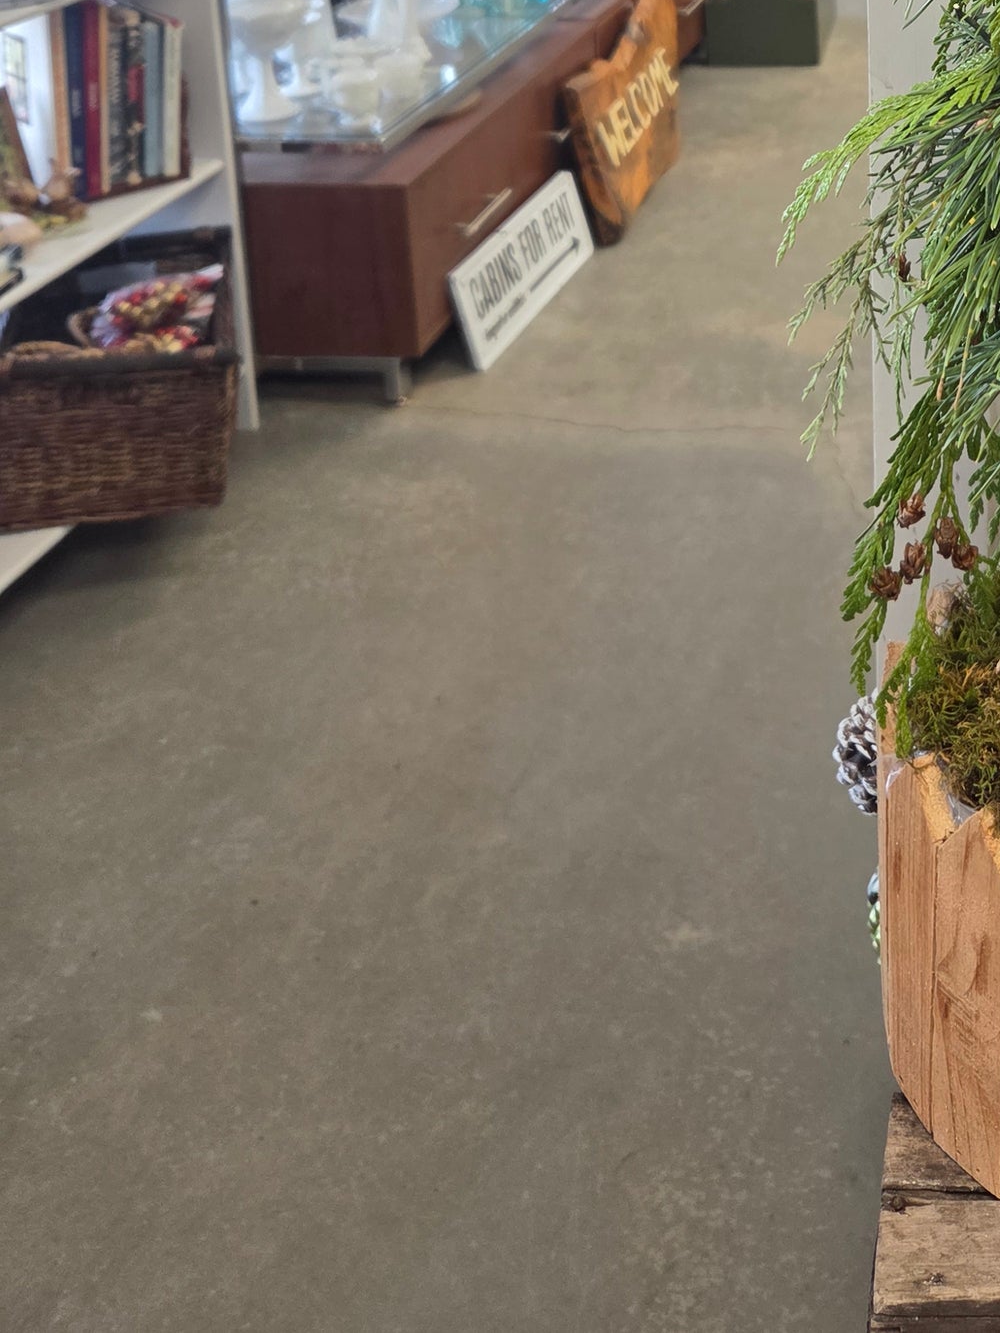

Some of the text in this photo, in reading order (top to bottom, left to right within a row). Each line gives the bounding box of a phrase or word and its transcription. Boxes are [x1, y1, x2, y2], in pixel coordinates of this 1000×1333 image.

[596, 47, 679, 166] WELCOME
[469, 241, 524, 320] CABINS
[517, 218, 548, 271] FOR
[542, 192, 576, 248] RENT
